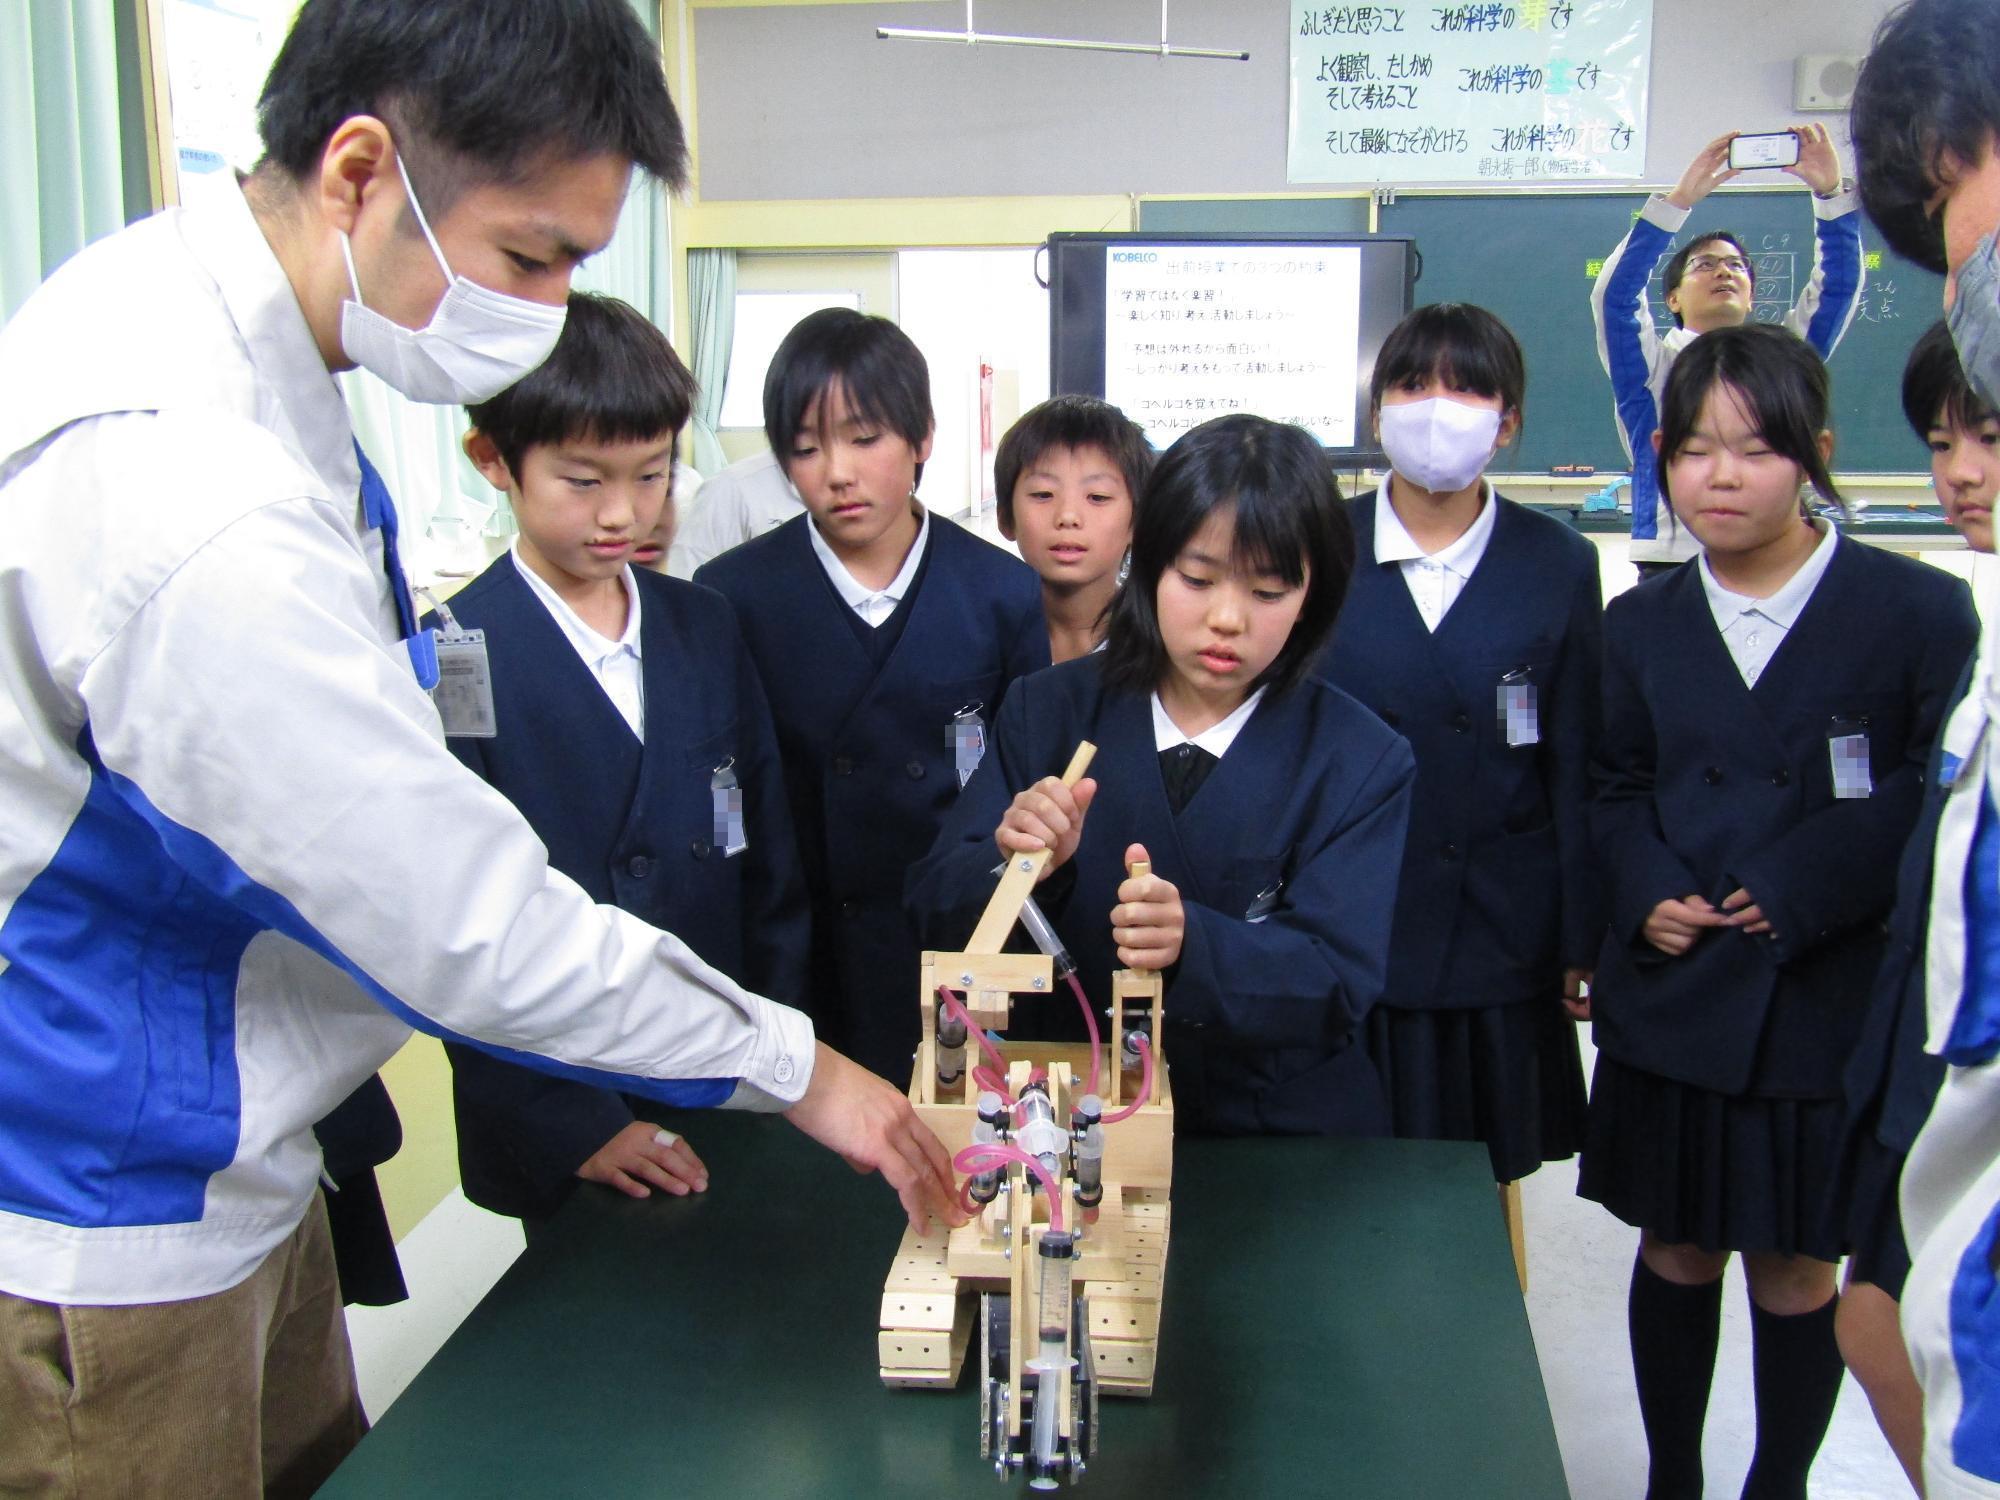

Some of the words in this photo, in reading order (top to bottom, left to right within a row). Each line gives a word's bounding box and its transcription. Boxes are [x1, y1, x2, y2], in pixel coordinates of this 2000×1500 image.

[1299, 6, 1406, 36] ふしぎだと思うこと
[1326, 85, 1419, 111] そして考えること
[1112, 252, 1158, 263] KOBELCO
